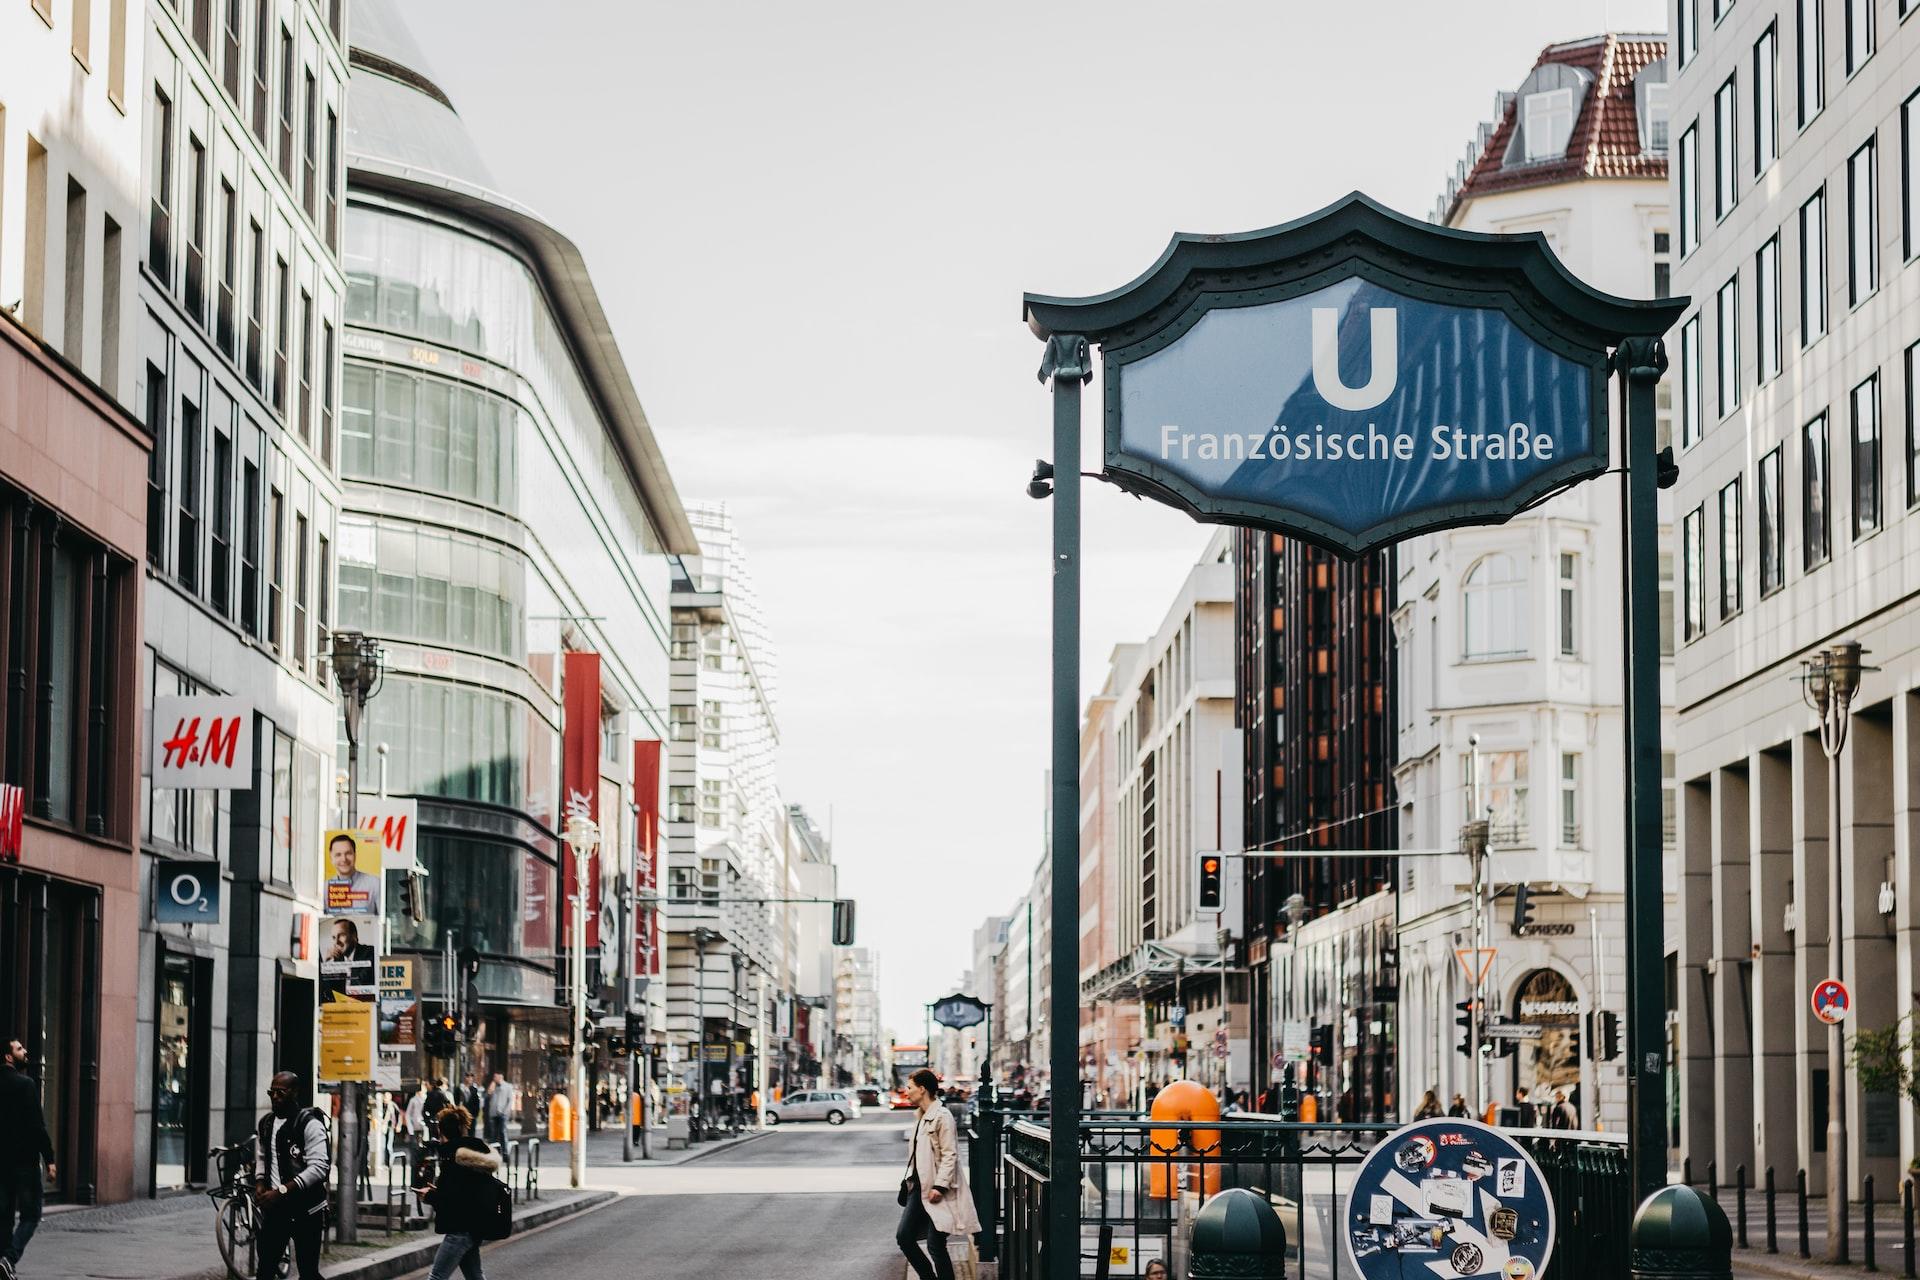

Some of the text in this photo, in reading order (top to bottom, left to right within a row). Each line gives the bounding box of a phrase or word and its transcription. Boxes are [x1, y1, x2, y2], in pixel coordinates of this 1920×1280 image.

[1312, 307, 1397, 411] U
[1160, 422, 1554, 460] Französische Straße
[162, 716, 241, 769] H&M
